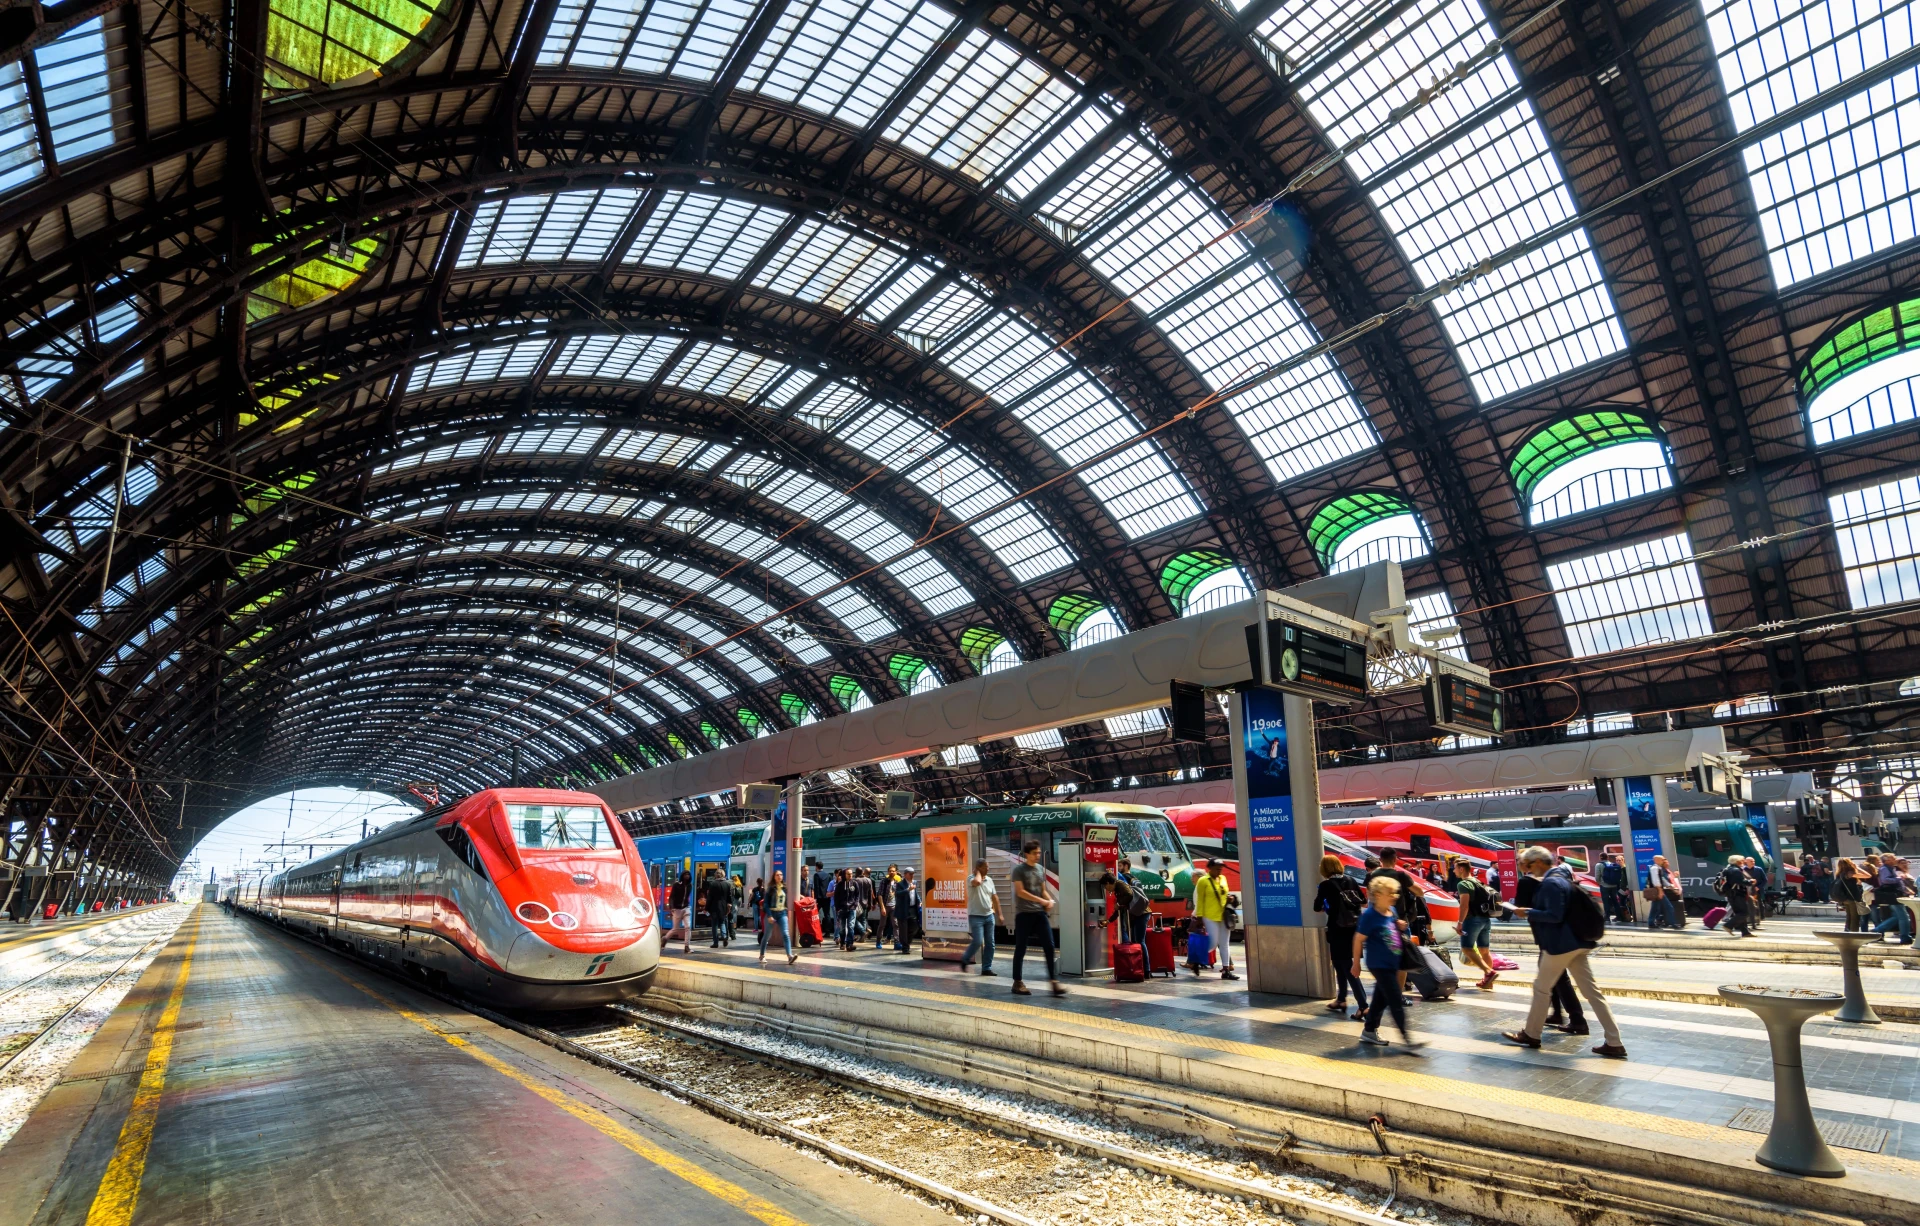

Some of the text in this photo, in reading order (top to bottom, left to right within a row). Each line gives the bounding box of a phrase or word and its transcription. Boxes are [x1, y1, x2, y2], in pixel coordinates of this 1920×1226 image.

[1284, 626, 1293, 642] 10
[1252, 718, 1283, 731] 19,90€
[1018, 810, 1073, 822] TRENORD
[1253, 807, 1283, 816] A Milano
[1273, 814, 1290, 822] PLUS
[730, 843, 755, 856] NORD
[1093, 847, 1111, 855] Biglietti
[1271, 870, 1295, 882] TIM
[935, 880, 966, 891] LA SALUTE
[933, 890, 966, 900] DISUGUALE
